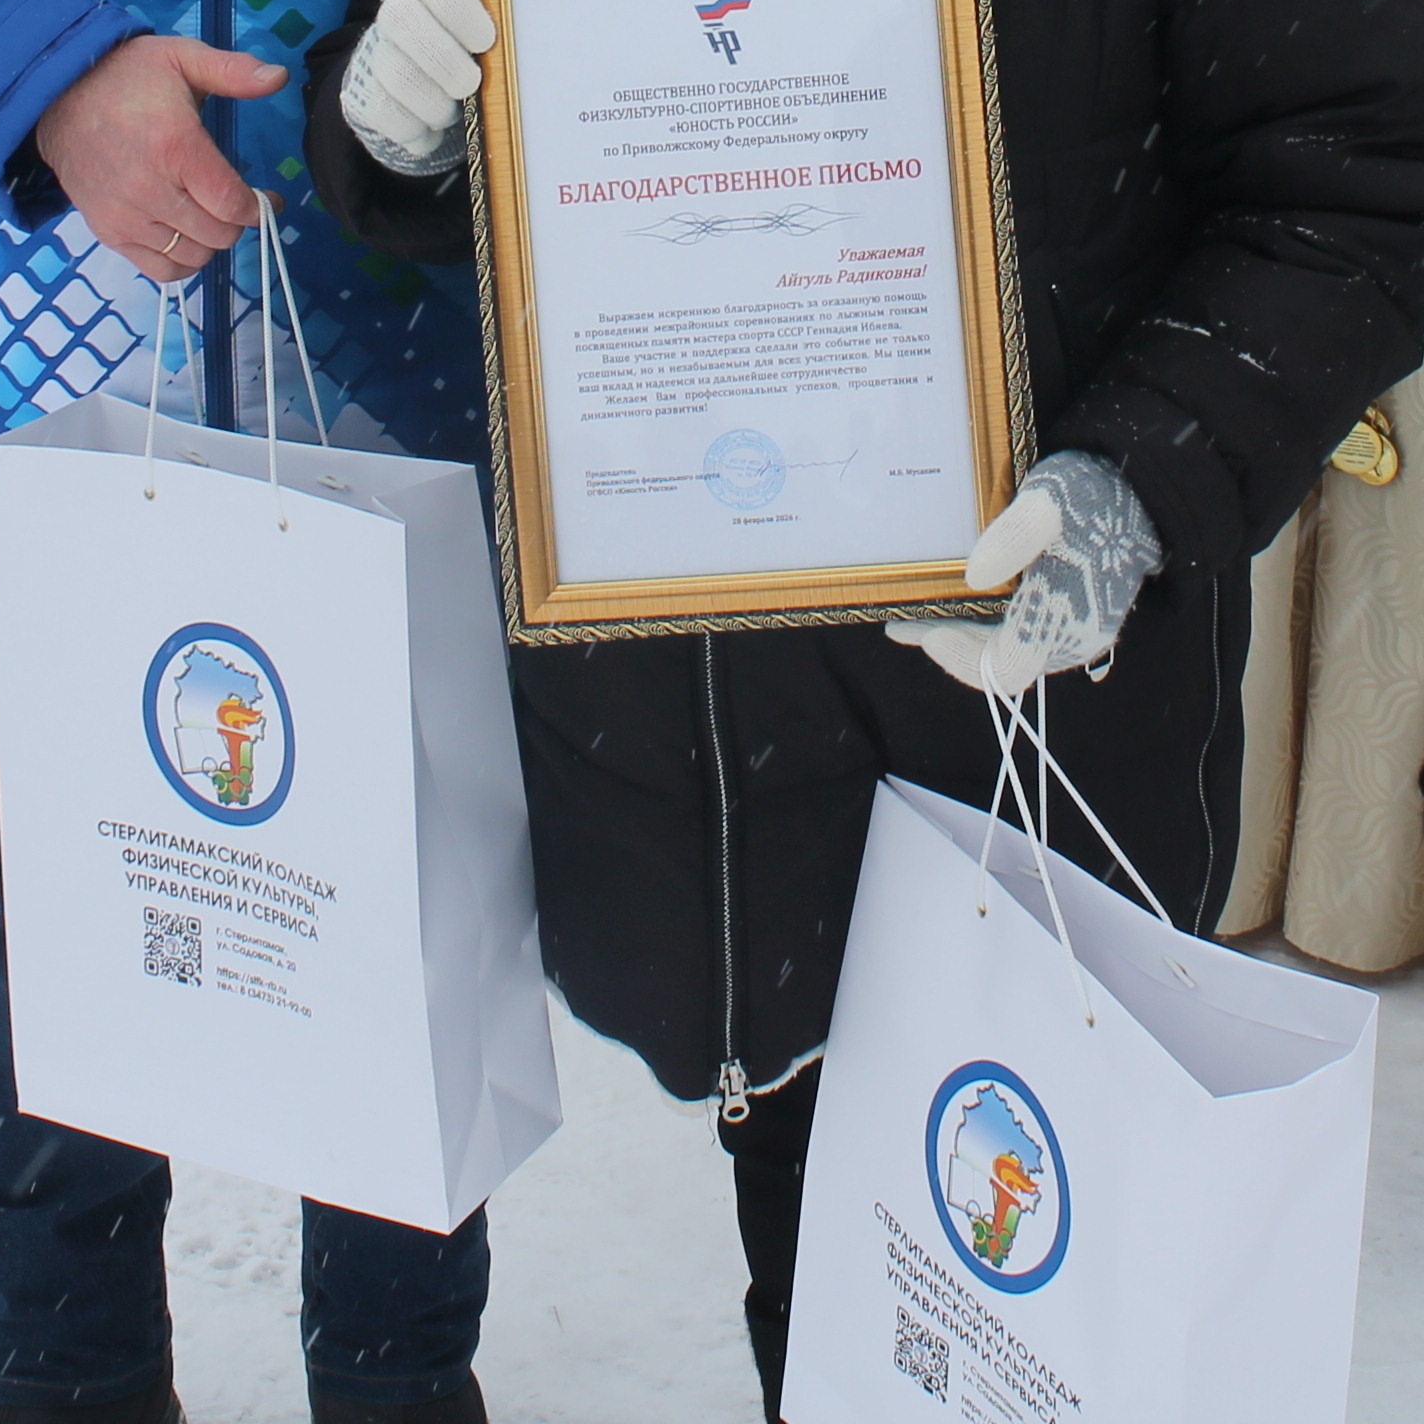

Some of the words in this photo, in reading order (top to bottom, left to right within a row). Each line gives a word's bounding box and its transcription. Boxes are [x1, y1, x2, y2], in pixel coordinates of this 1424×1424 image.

[613, 83, 715, 103] ОБЩЕСТВЕННО
[719, 73, 850, 95] ГОСУДАРСТВЕННОЕ
[578, 96, 781, 123] ФИЗКУЛЬТУРНО-СПОРТИВНОЕ
[783, 88, 888, 107] ОБЪЕДИНЕНИЕ
[669, 119, 734, 134] «ЮНОСТЬ
[737, 113, 798, 128] РОССИИ»
[603, 146, 619, 157] по
[622, 138, 720, 158] Приволжскому
[723, 131, 821, 148] Федеральному
[824, 128, 869, 142] округу
[558, 166, 812, 205] БЛАГОДАРСТВЕННОЕ
[819, 158, 922, 185] ПИСЬМО
[838, 246, 926, 263] Уважаемая
[776, 274, 833, 289] Айгуль
[836, 264, 928, 285] Радиковна!
[574, 331, 580, 339] в
[585, 326, 649, 339] проведении
[653, 320, 729, 335] межрайонных
[733, 314, 815, 328] соревнованиях
[819, 313, 832, 321] по
[837, 309, 885, 320] лыжным
[889, 306, 928, 316] гонкам
[599, 310, 654, 324] Выражаем
[658, 306, 720, 321] искреннюю
[724, 301, 804, 314] благодарность
[807, 300, 818, 308] за
[821, 296, 881, 308] оказанную
[884, 292, 927, 303] помощь
[575, 338, 649, 352] посвященных
[651, 337, 691, 348] памяти
[693, 333, 736, 345] мастера
[738, 330, 775, 341] спорта
[777, 327, 804, 338] СССР
[806, 324, 859, 336] Геннадия
[602, 354, 630, 364] Ваше
[634, 350, 676, 364] участие
[692, 345, 751, 359] поддержка
[755, 342, 798, 354] сделали
[803, 341, 821, 350] это
[825, 337, 871, 348] событие
[875, 336, 888, 344] не
[893, 333, 930, 343] только
[577, 367, 637, 382] успешным,
[640, 367, 654, 375] но
[669, 359, 750, 373] незабываемым
[754, 358, 774, 369] для
[778, 356, 801, 365] всех
[874, 348, 893, 358] Мы
[897, 347, 931, 359] ценим
[579, 385, 600, 394] ваш
[602, 381, 634, 393] вклад
[645, 377, 695, 389] надеемся
[697, 376, 711, 384] на
[713, 371, 778, 385] дальнейшее
[780, 365, 868, 380] сотрудничество
[605, 394, 648, 405] Желаем
[656, 392, 676, 401] Вам
[685, 383, 788, 401] профессиональных
[795, 381, 841, 395] успехов,
[848, 376, 919, 390] процветания
[580, 407, 652, 422] динамичного
[655, 402, 709, 417] развития!
[97, 820, 263, 873] СТЕРЛИТАМАКСКИЙ
[266, 859, 337, 903] КОЛЛЕДЖ
[122, 847, 238, 889] ФИЗИЧЕСКОЙ
[242, 875, 319, 921] КУЛЬТУРЫ,
[125, 871, 233, 912] УПРАВЛЕНИЯ
[236, 897, 248, 916] И
[251, 902, 319, 943] СЕРВИСА
[874, 1202, 1004, 1339] СТЕРЛИТАМАКСКИЙ
[1008, 1332, 1082, 1414] КОЛЛЕДЖ
[887, 1262, 978, 1354] УПРАВЛЕНИЯ
[981, 1346, 991, 1366] И
[887, 1242, 982, 1338] ФИЗИЧЕСКОЙ
[986, 1331, 1061, 1417] КУЛЬТУРЫ,
